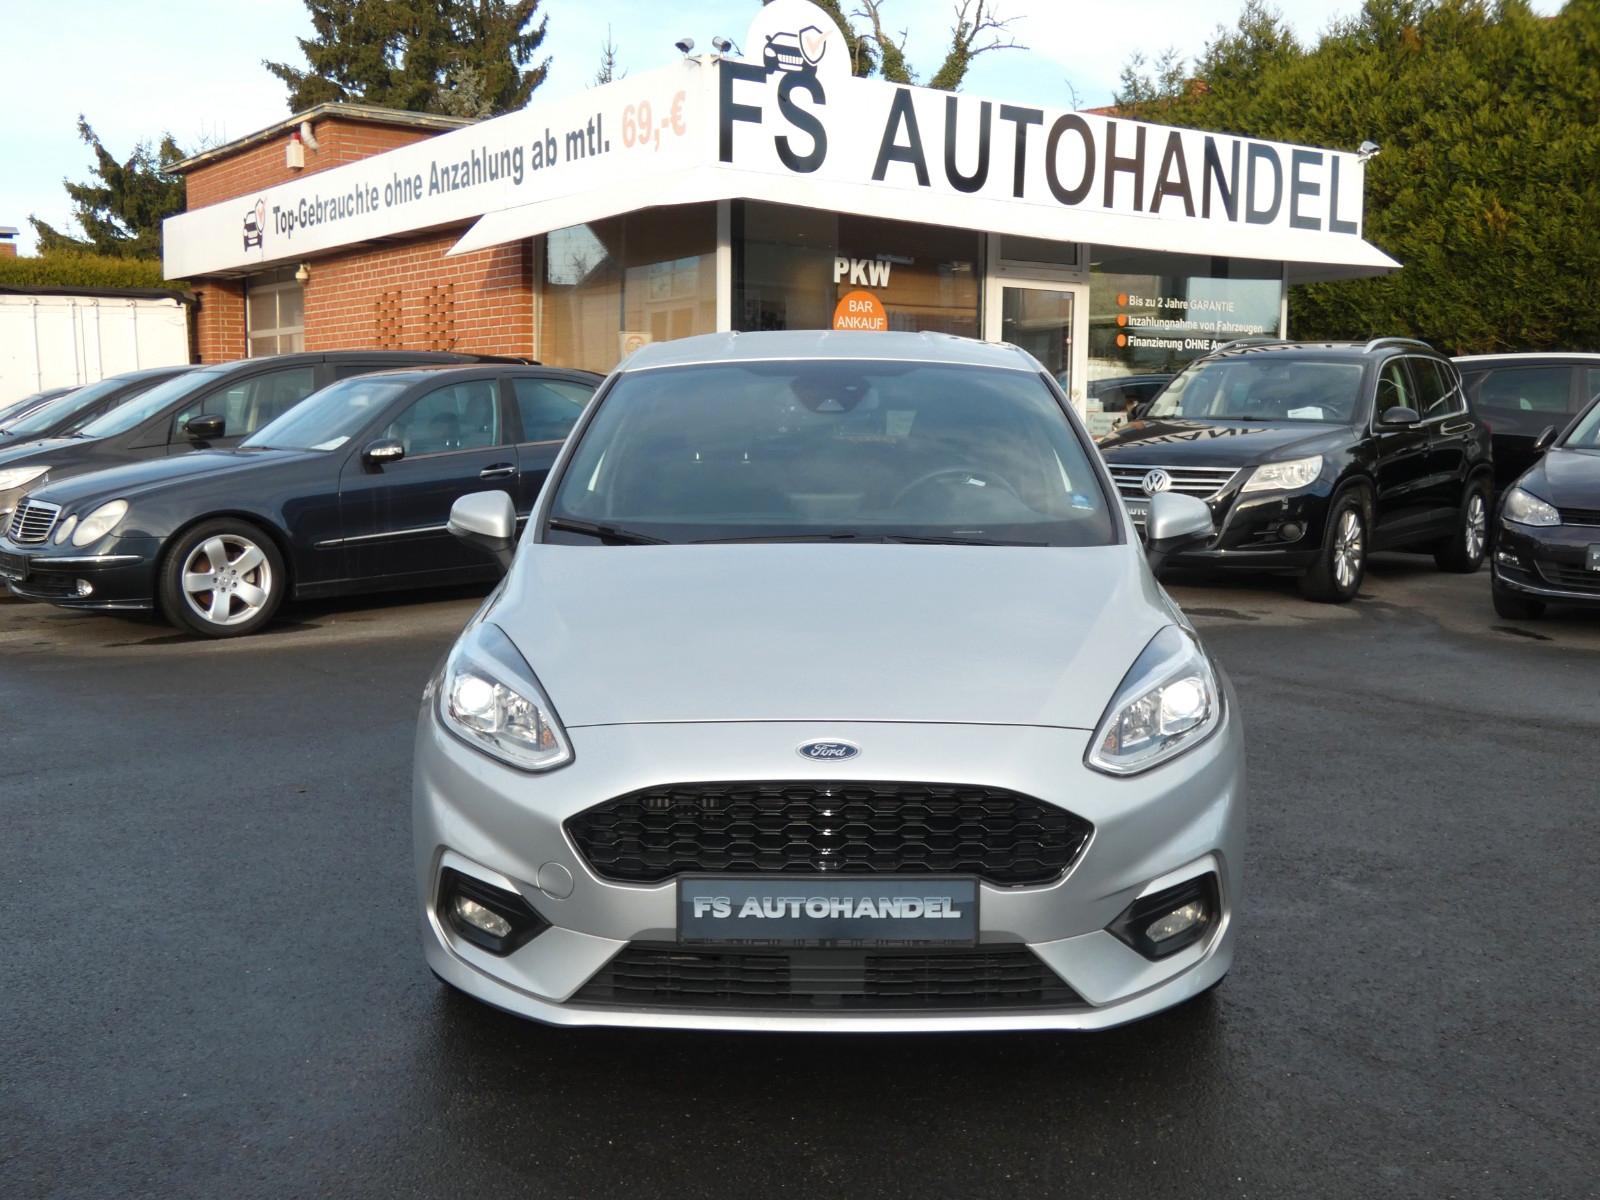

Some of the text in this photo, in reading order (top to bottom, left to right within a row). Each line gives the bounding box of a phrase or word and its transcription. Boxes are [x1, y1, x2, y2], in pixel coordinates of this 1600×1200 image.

[719, 58, 1358, 235] FS AUTOHANDEL
[272, 90, 687, 239] Top-Gebrauchte ohne Anzahlung ab mtl. 69,-€
[833, 256, 891, 287] PKW
[849, 300, 873, 313] BAR
[1129, 295, 1235, 312] Bis zu 2 Jahre GARANTIE
[837, 316, 884, 330] ANKAUF
[1128, 315, 1263, 335] Inzahlungnahme von Fahrzeugen
[1128, 336, 1183, 351] Finanzierung
[1184, 338, 1210, 350] OHNE
[809, 743, 847, 758] Ford
[693, 896, 962, 919] FS AUTOHANDEL
